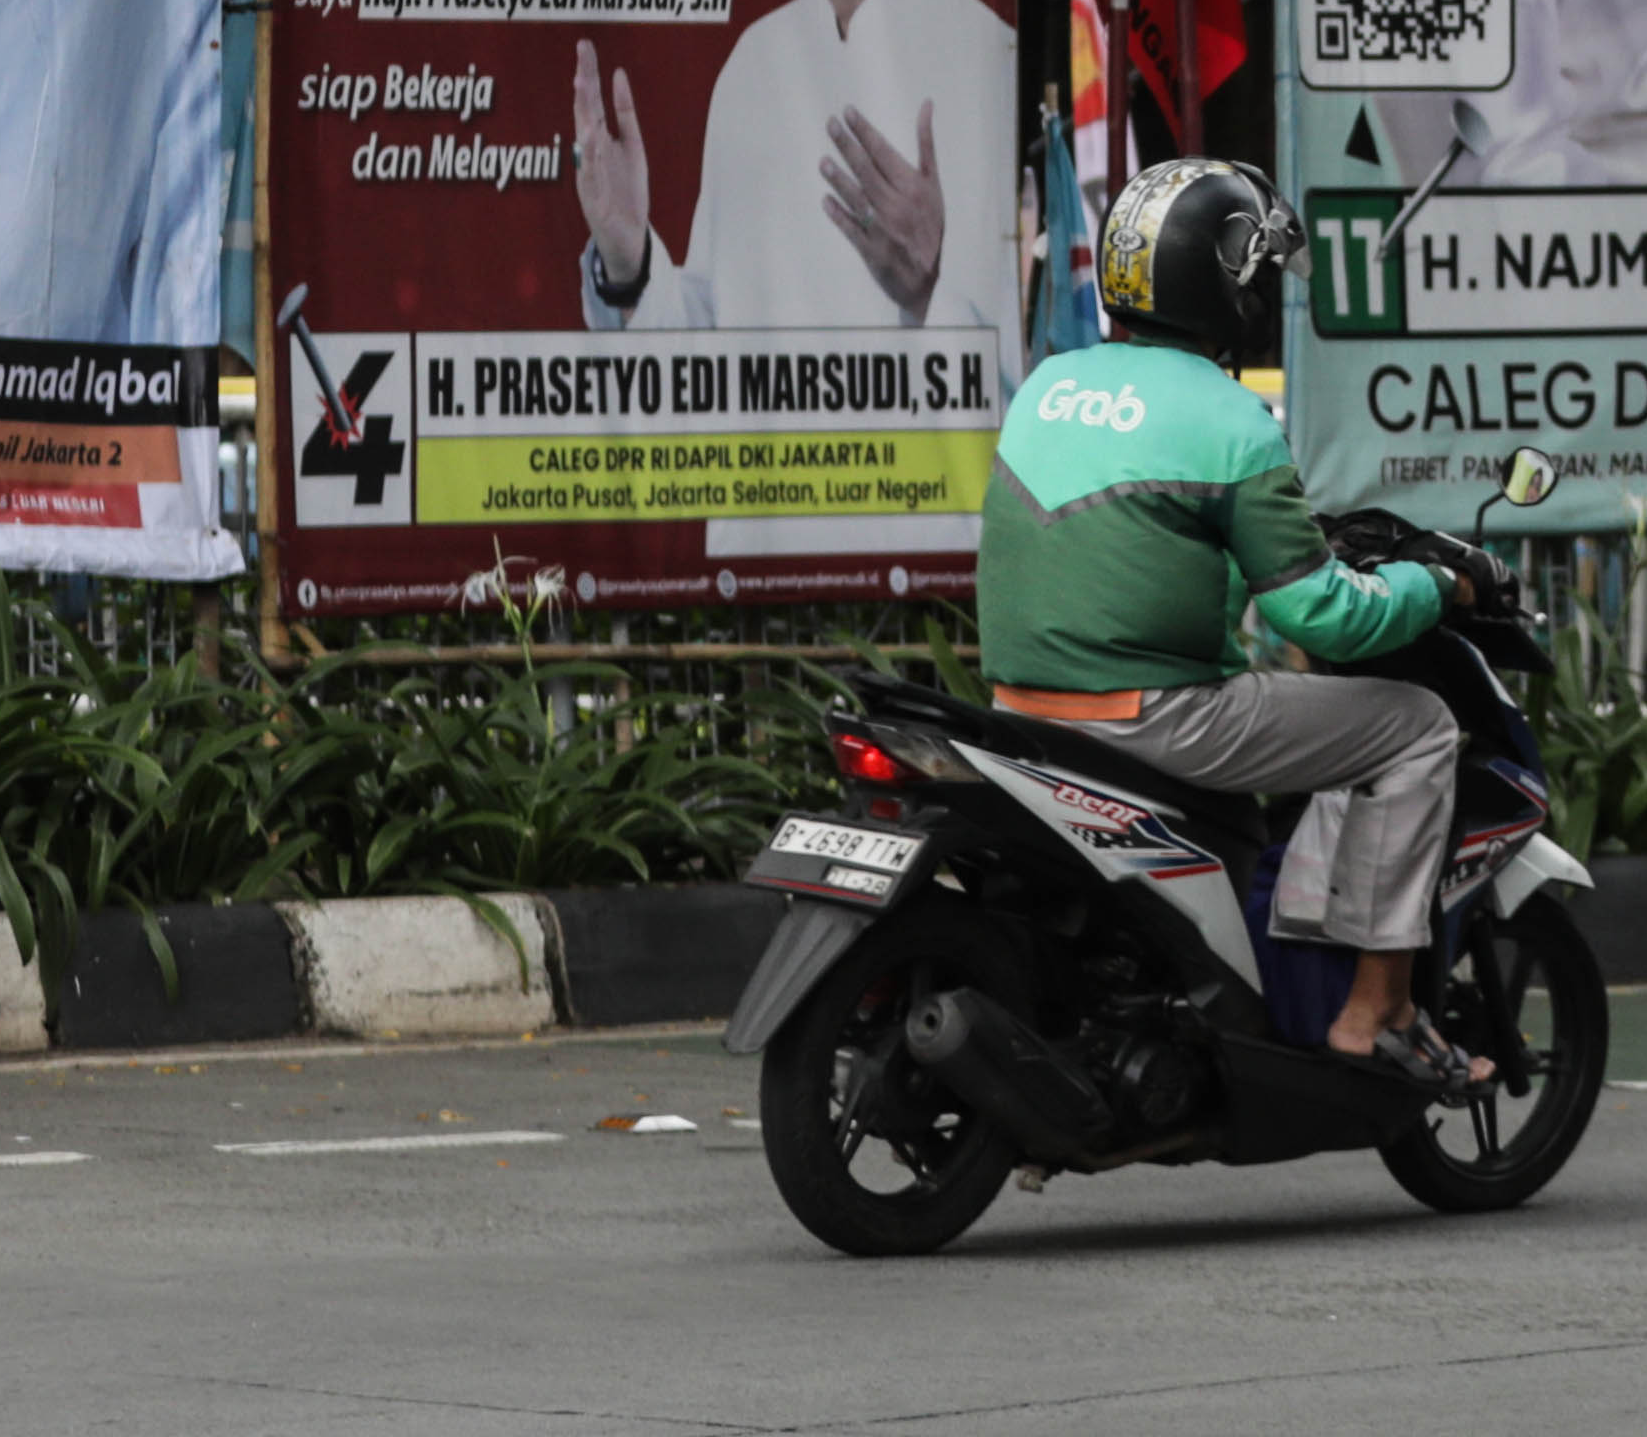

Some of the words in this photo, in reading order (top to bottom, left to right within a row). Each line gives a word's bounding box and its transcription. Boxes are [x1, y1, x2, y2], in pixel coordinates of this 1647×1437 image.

[297, 63, 378, 121] siap
[382, 63, 494, 121] Bekerja
[351, 132, 422, 181] dan
[428, 133, 561, 192] Melayani
[1422, 234, 1479, 291] H.
[83, 357, 181, 417] Iqbal
[427, 358, 465, 417] H.
[474, 355, 662, 417] PRASETYO
[671, 355, 729, 414] EDI
[738, 352, 920, 417] MARSUDI,
[924, 354, 993, 412] S.H.
[1037, 378, 1147, 434] Grab
[1367, 360, 1597, 434] CALEG
[19, 436, 101, 467] Jakarta
[105, 441, 123, 467] 2
[299, 350, 406, 506] 4
[529, 445, 600, 475] CALEG
[604, 445, 645, 472] DPR
[651, 446, 671, 470] RI
[673, 444, 734, 471] DAPIL
[739, 443, 775, 469] DKI
[778, 441, 877, 469] JAKARTA
[881, 440, 897, 467] II
[481, 482, 567, 512] Jakarta
[571, 481, 638, 512] Pusat,
[643, 478, 727, 510] Jakarta
[731, 477, 820, 508] Selatan,
[824, 476, 873, 504] Luar
[876, 474, 948, 510] Negeri
[776, 822, 798, 848] B
